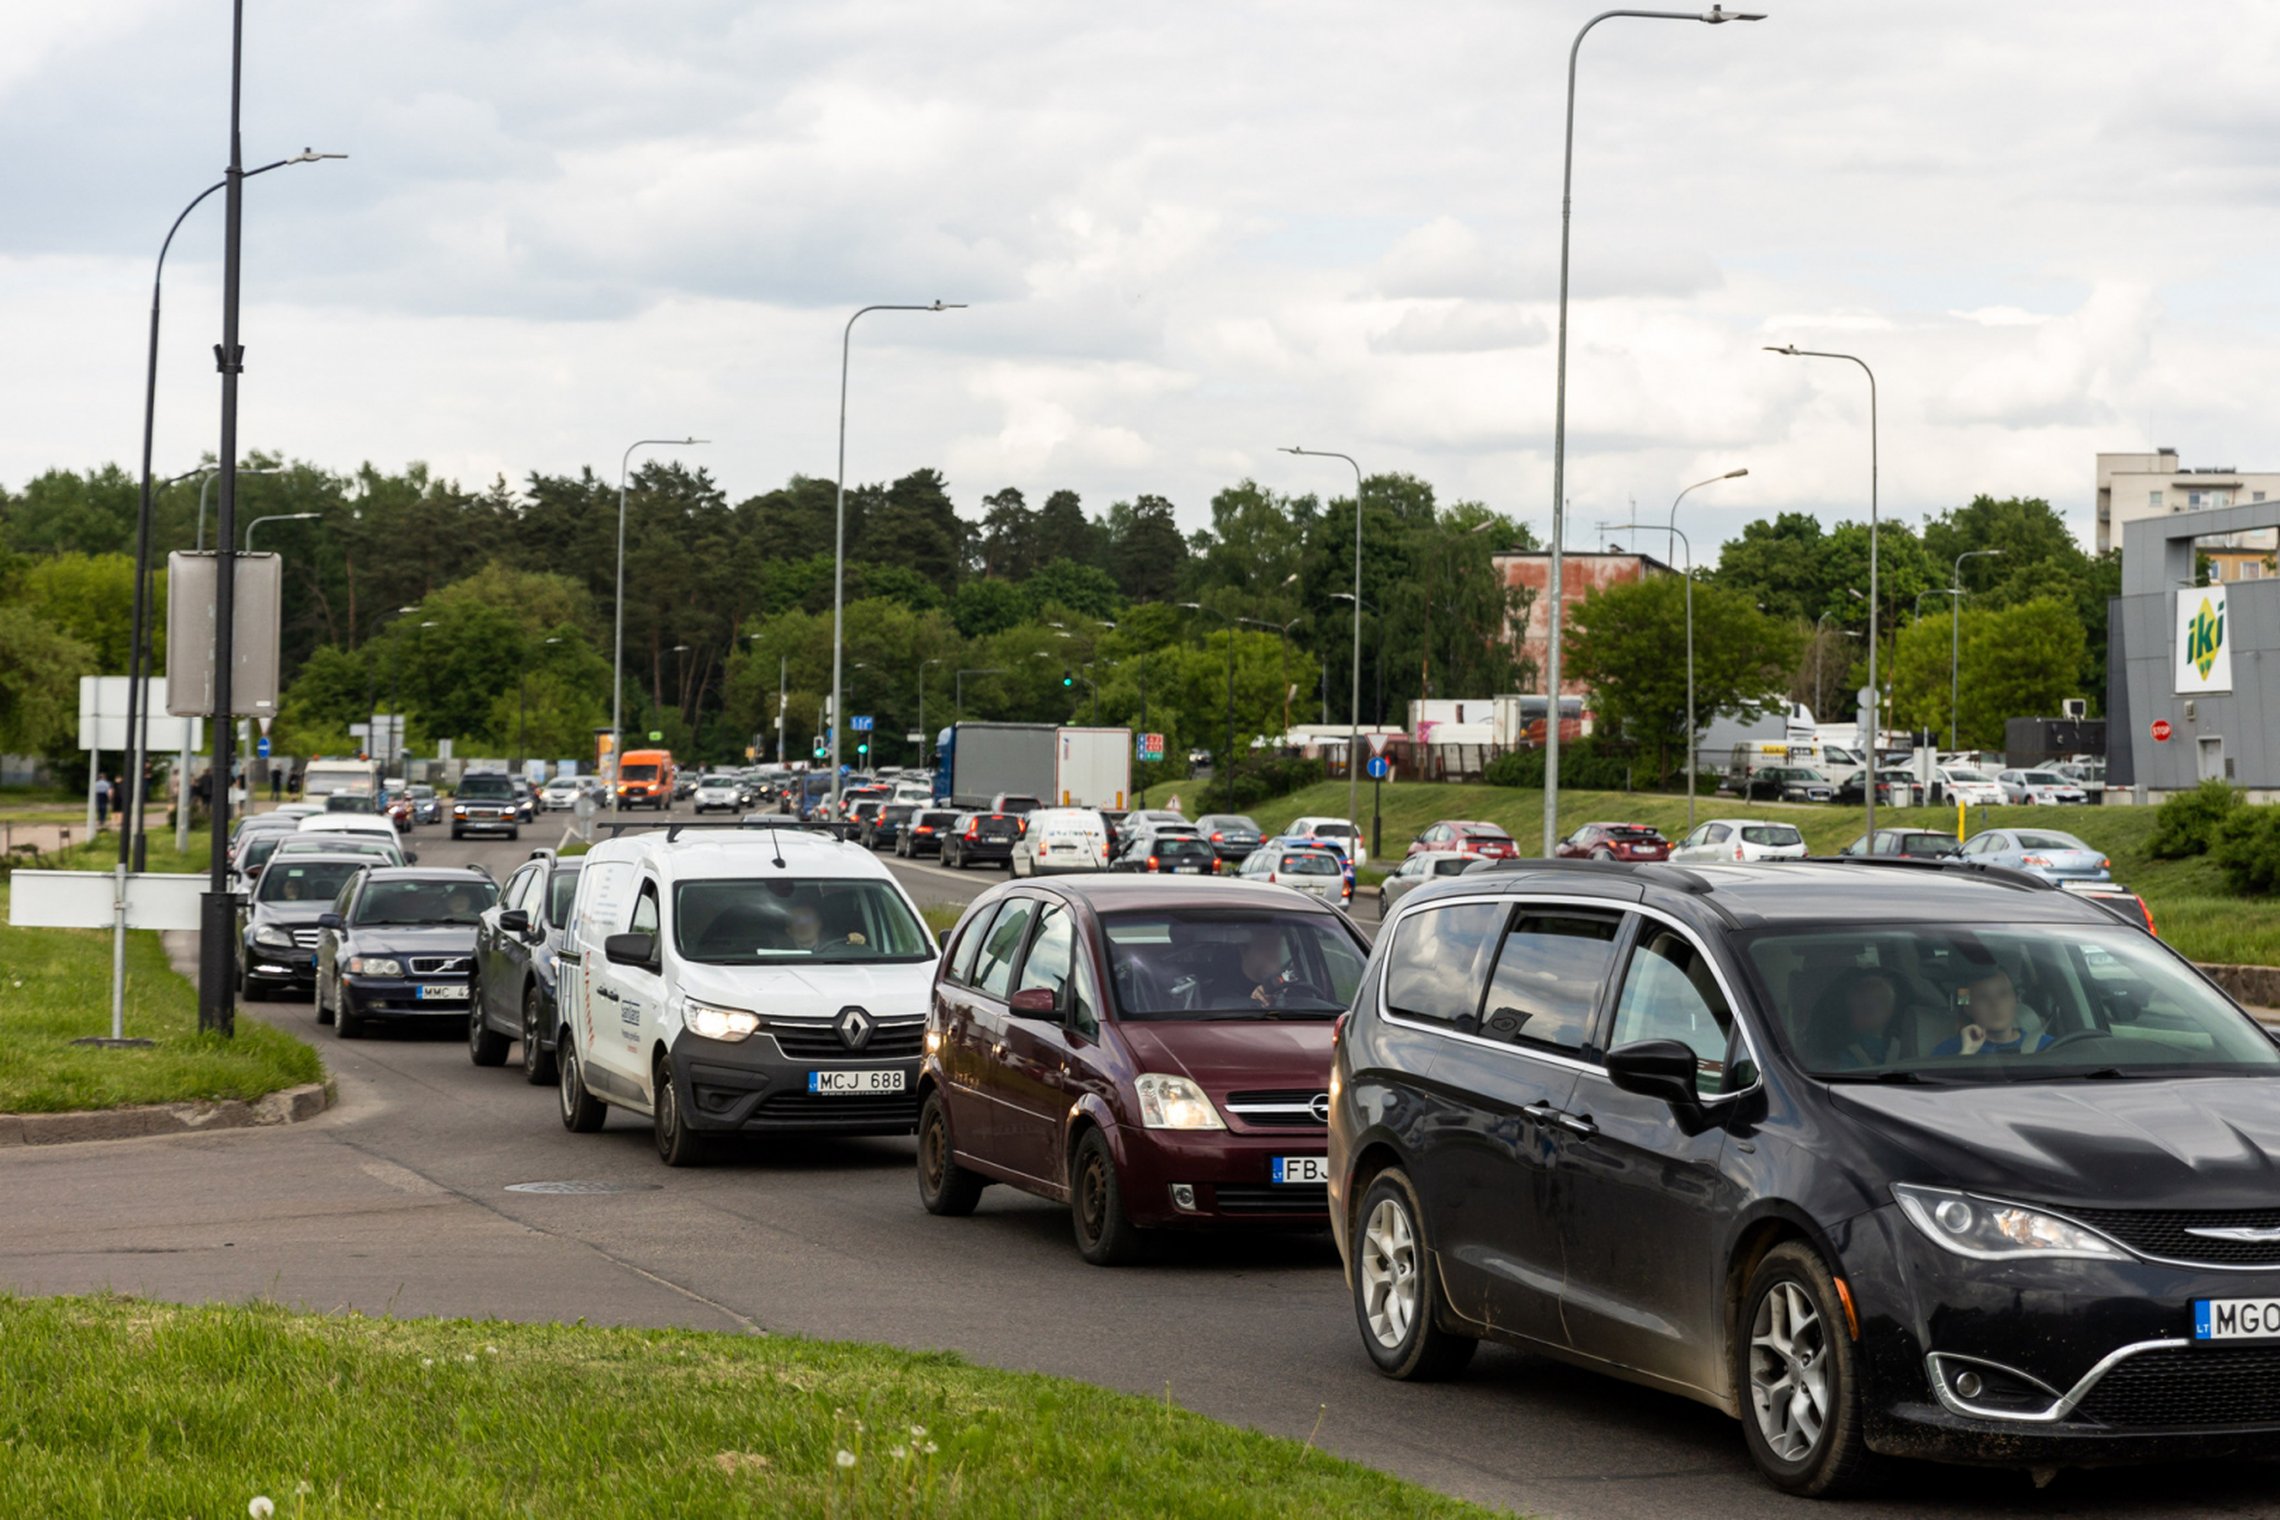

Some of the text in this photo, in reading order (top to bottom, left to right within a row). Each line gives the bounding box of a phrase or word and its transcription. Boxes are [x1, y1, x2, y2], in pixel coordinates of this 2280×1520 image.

[2187, 600, 2225, 665] iki
[2152, 725, 2170, 735] STOP
[424, 987, 449, 998] MMC
[820, 1073, 902, 1089] MCJ 688
[2196, 1323, 2209, 1334] LT
